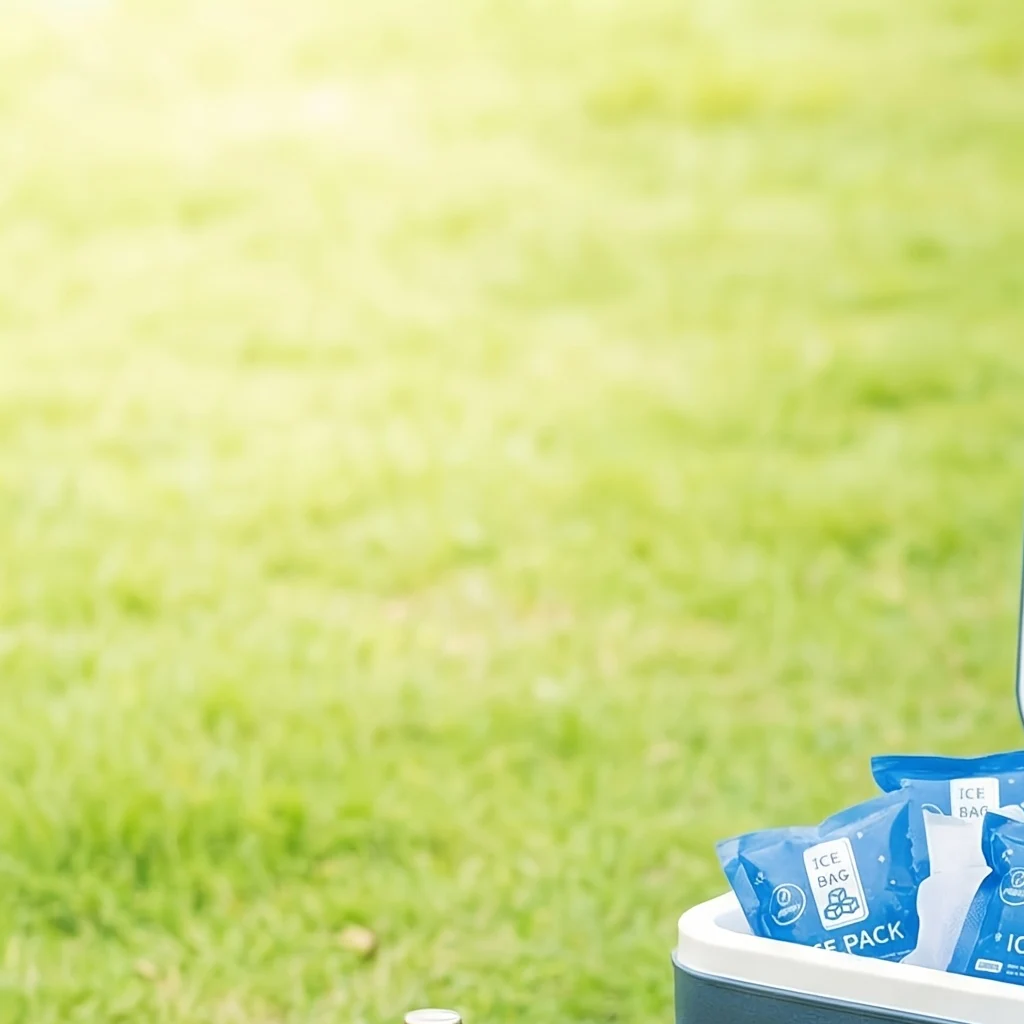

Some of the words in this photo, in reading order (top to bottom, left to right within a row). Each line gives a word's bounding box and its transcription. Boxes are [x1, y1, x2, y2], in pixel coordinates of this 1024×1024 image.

[960, 787, 985, 800] ICE
[812, 852, 842, 870] ICE
[817, 869, 850, 888] BAG
[843, 921, 905, 954] PACK
